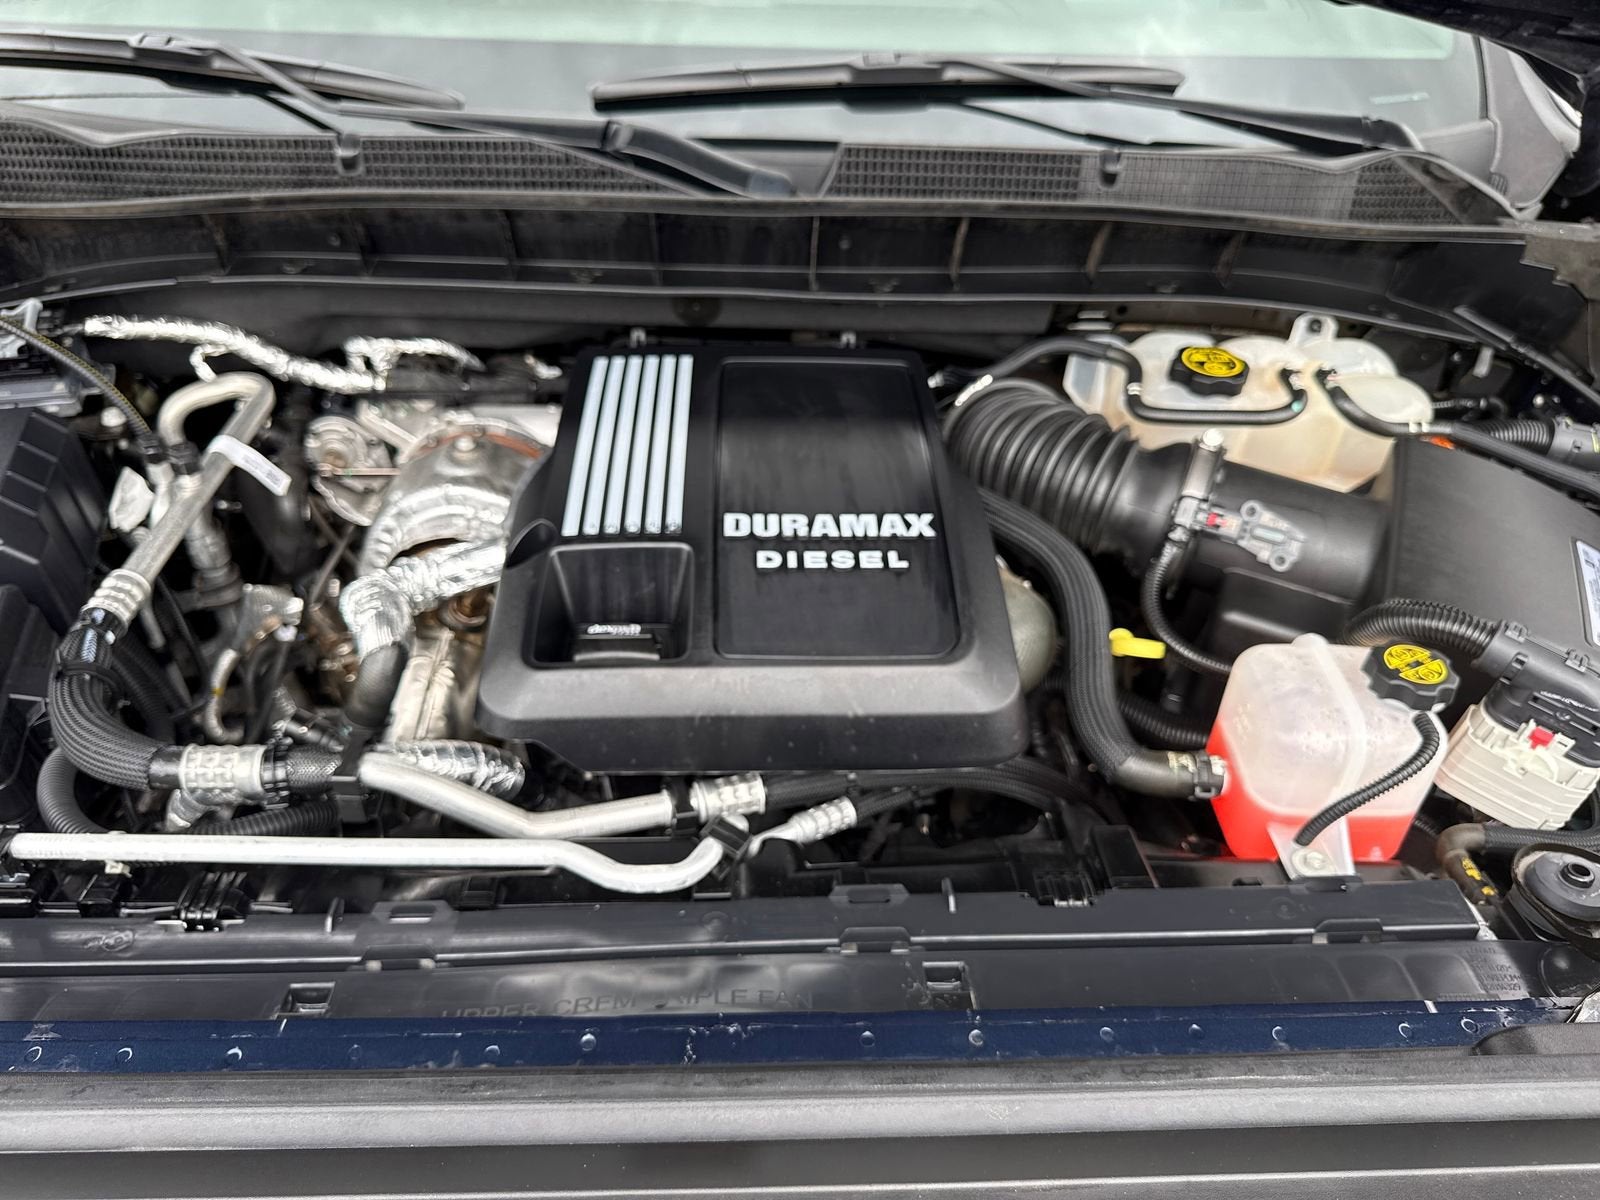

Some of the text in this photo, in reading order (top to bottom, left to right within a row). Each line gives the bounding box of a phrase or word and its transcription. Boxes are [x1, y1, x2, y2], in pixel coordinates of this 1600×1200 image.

[722, 512, 937, 538] DURAMAX
[755, 550, 910, 569] DIESEL
[758, 989, 814, 1009] FAN
